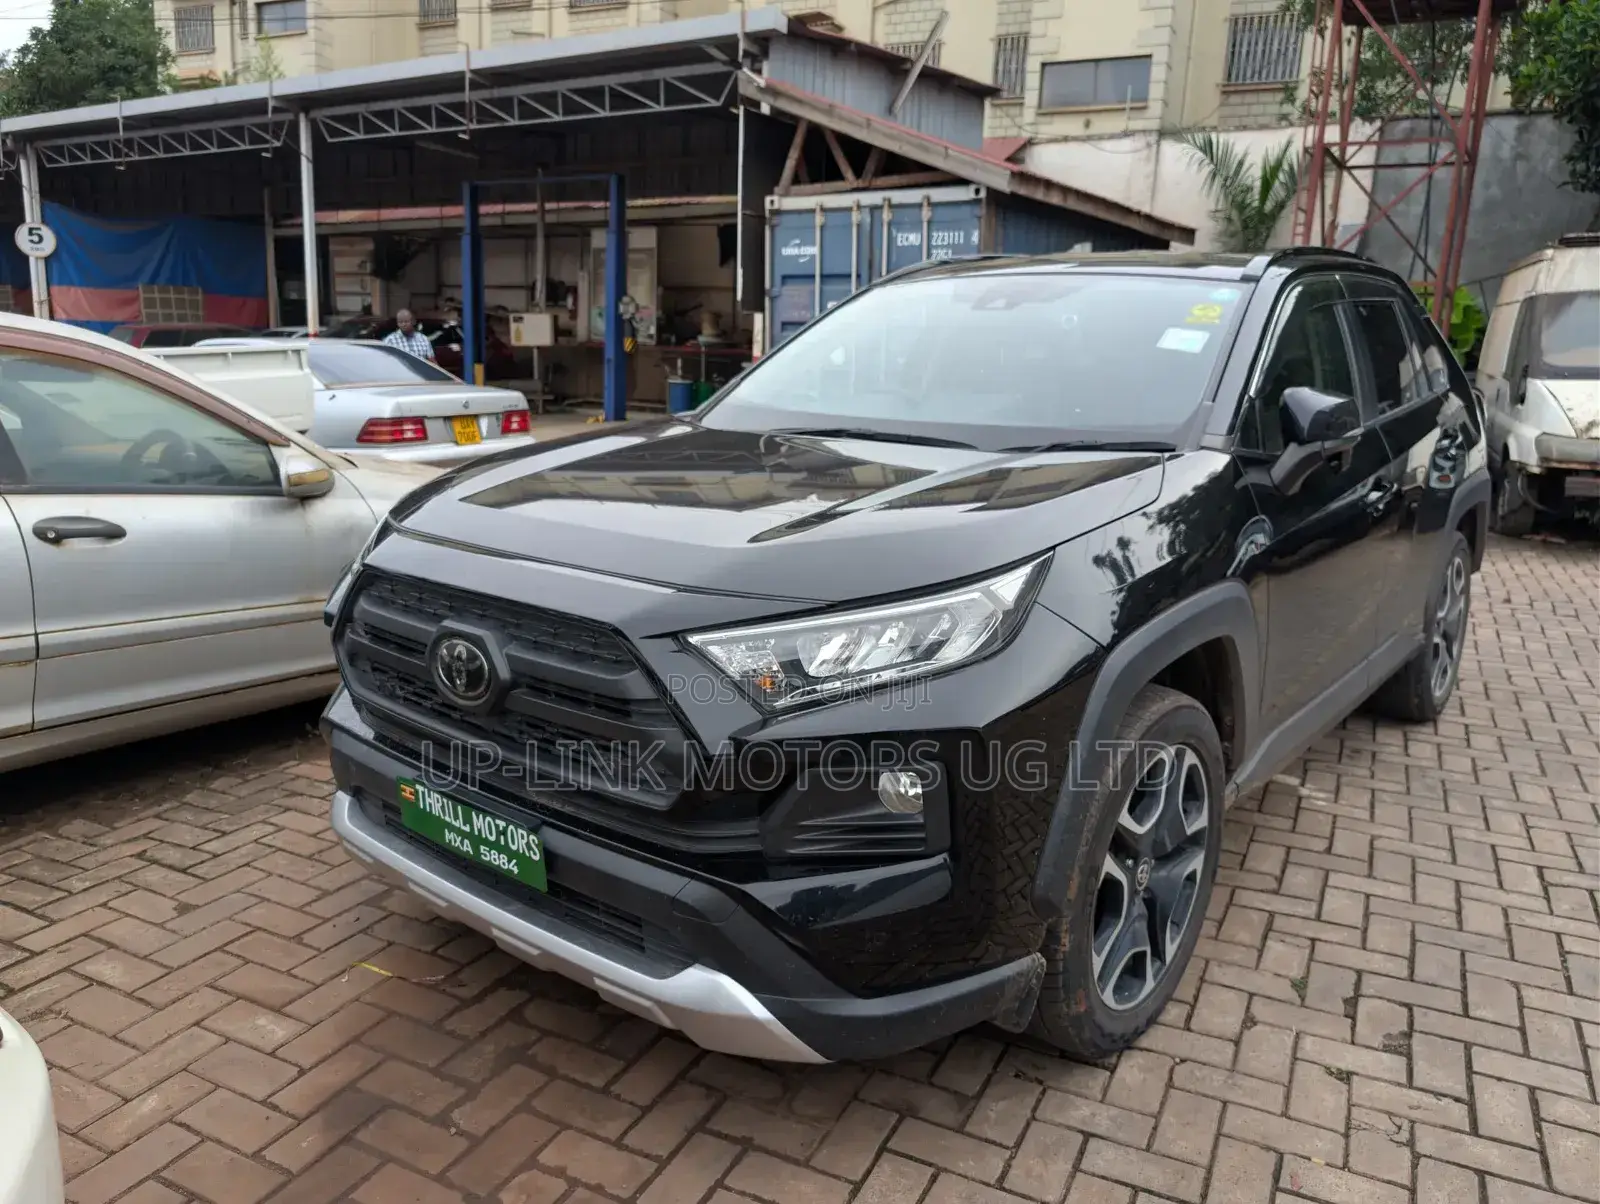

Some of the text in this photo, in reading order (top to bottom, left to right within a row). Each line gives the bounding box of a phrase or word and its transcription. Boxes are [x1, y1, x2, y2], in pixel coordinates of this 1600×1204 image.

[28, 227, 44, 245] 5
[896, 232, 921, 247] ECMU
[931, 230, 964, 246] 223111
[415, 784, 541, 862] THRILL MOTORS
[444, 828, 520, 875] MXA 5884
